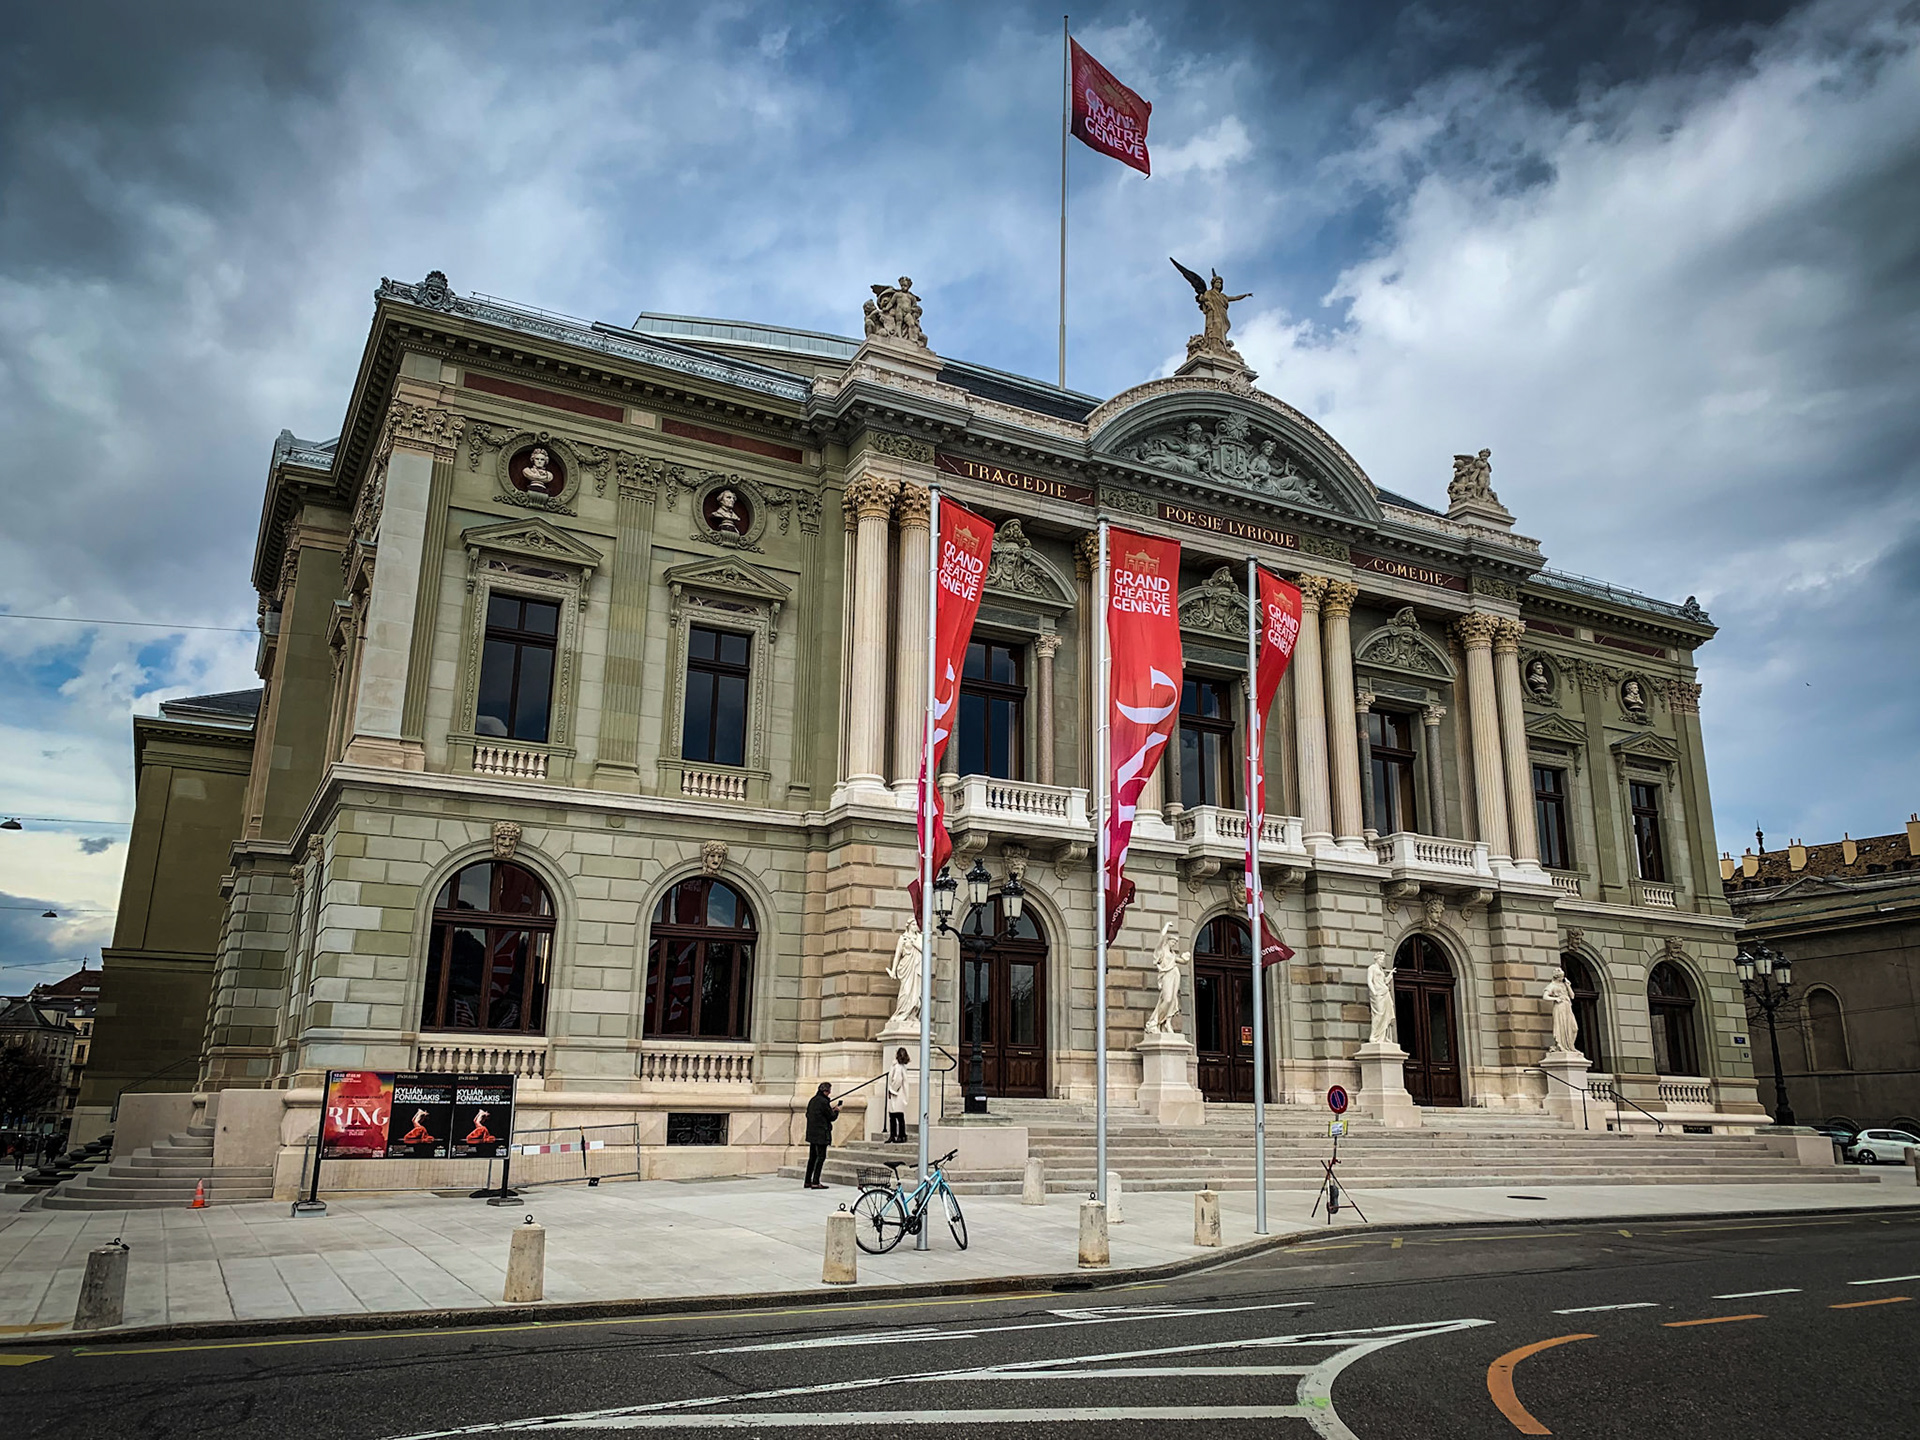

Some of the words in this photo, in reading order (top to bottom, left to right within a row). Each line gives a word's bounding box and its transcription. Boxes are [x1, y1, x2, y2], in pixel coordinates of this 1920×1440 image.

[963, 461, 1067, 499] TRAGEDIE
[1165, 506, 1222, 531] POESIE
[1229, 521, 1295, 548] LYRIQUE
[944, 540, 984, 574] GRAND
[1114, 568, 1170, 592] GRAND
[1373, 559, 1444, 586] COMEDIE
[1268, 603, 1299, 634] GRAND
[394, 1087, 423, 1095] KYLIÁN
[456, 1088, 484, 1096] KYLIÁN
[328, 1106, 389, 1126] RING
